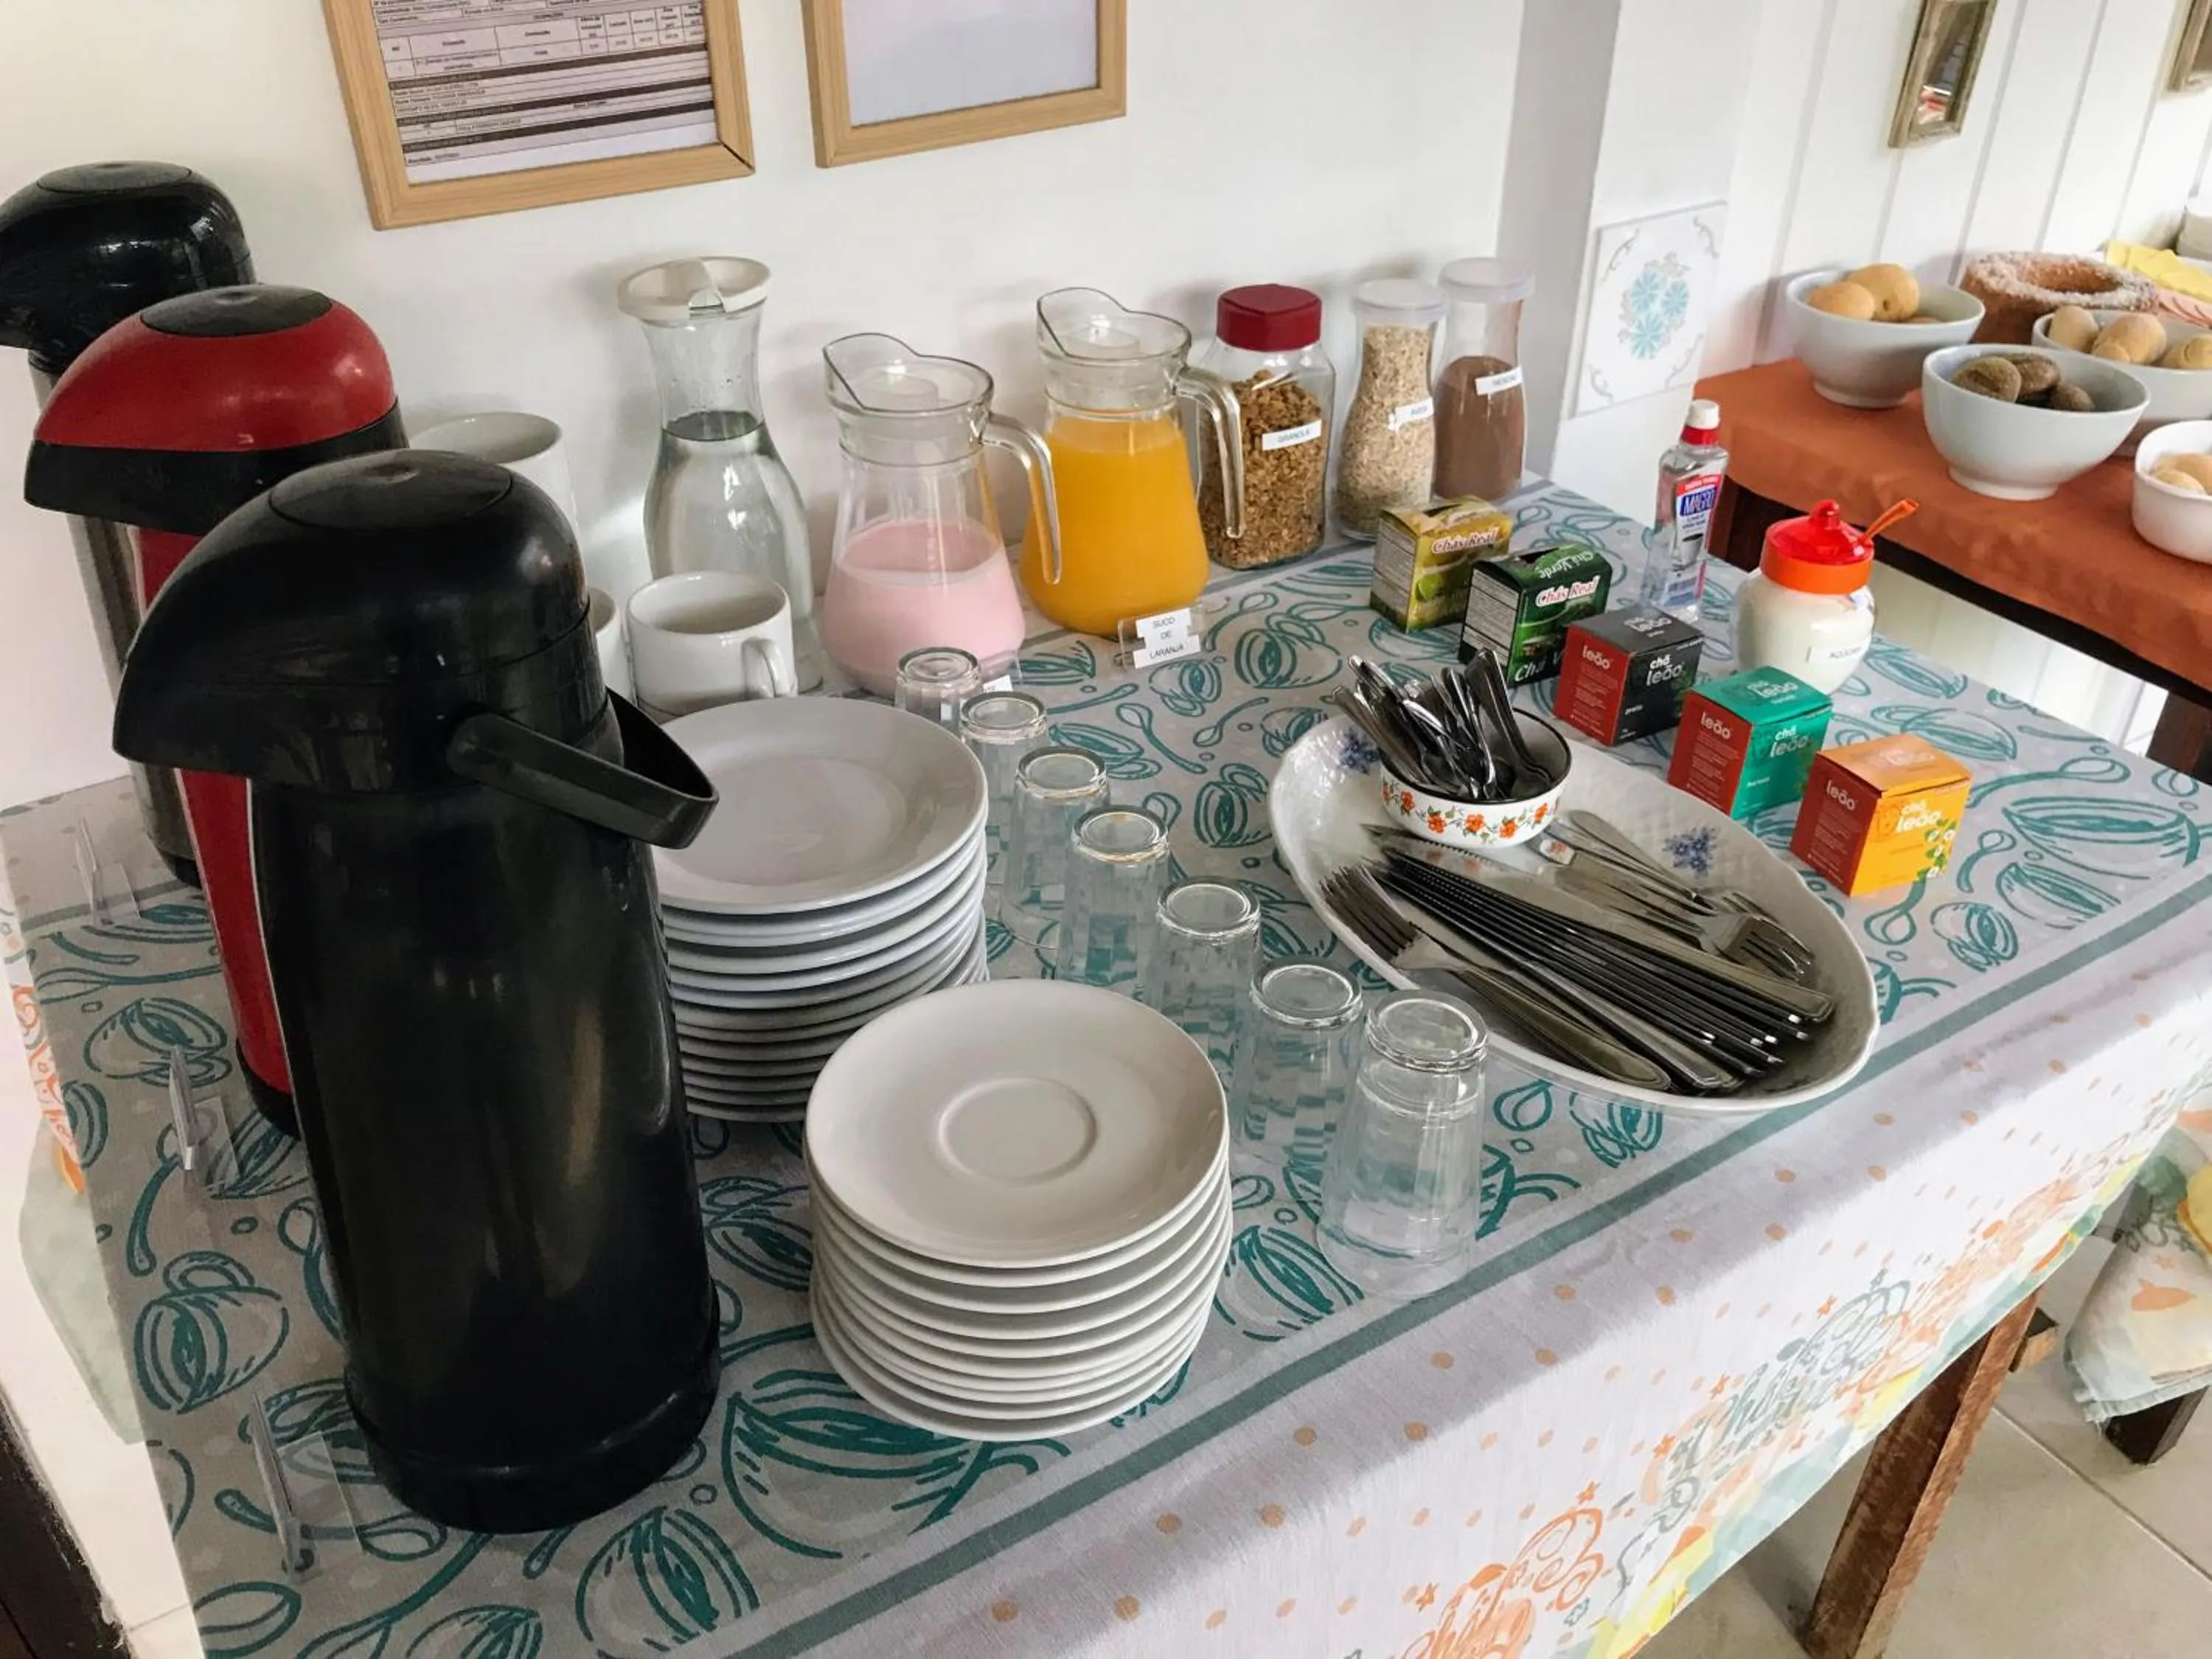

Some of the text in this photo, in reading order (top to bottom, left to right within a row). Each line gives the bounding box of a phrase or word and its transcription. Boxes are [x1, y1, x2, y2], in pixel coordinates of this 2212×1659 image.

[1468, 526, 1499, 547] Real
[1538, 557, 1573, 579] Verde
[1568, 575, 1601, 599] Real
[1152, 616, 1176, 628] SUCO
[1160, 630, 1173, 640] DE
[1150, 643, 1184, 659] LARANJA
[1582, 644, 1610, 669] leão
[1649, 653, 1671, 669] chá
[1646, 663, 1683, 686] leão
[1700, 711, 1731, 740] leão
[1775, 726, 1797, 741] chá
[1770, 735, 1809, 758] leão
[1826, 780, 1855, 810] leão
[1901, 801, 1927, 815] chá
[1895, 811, 1942, 833] leão
